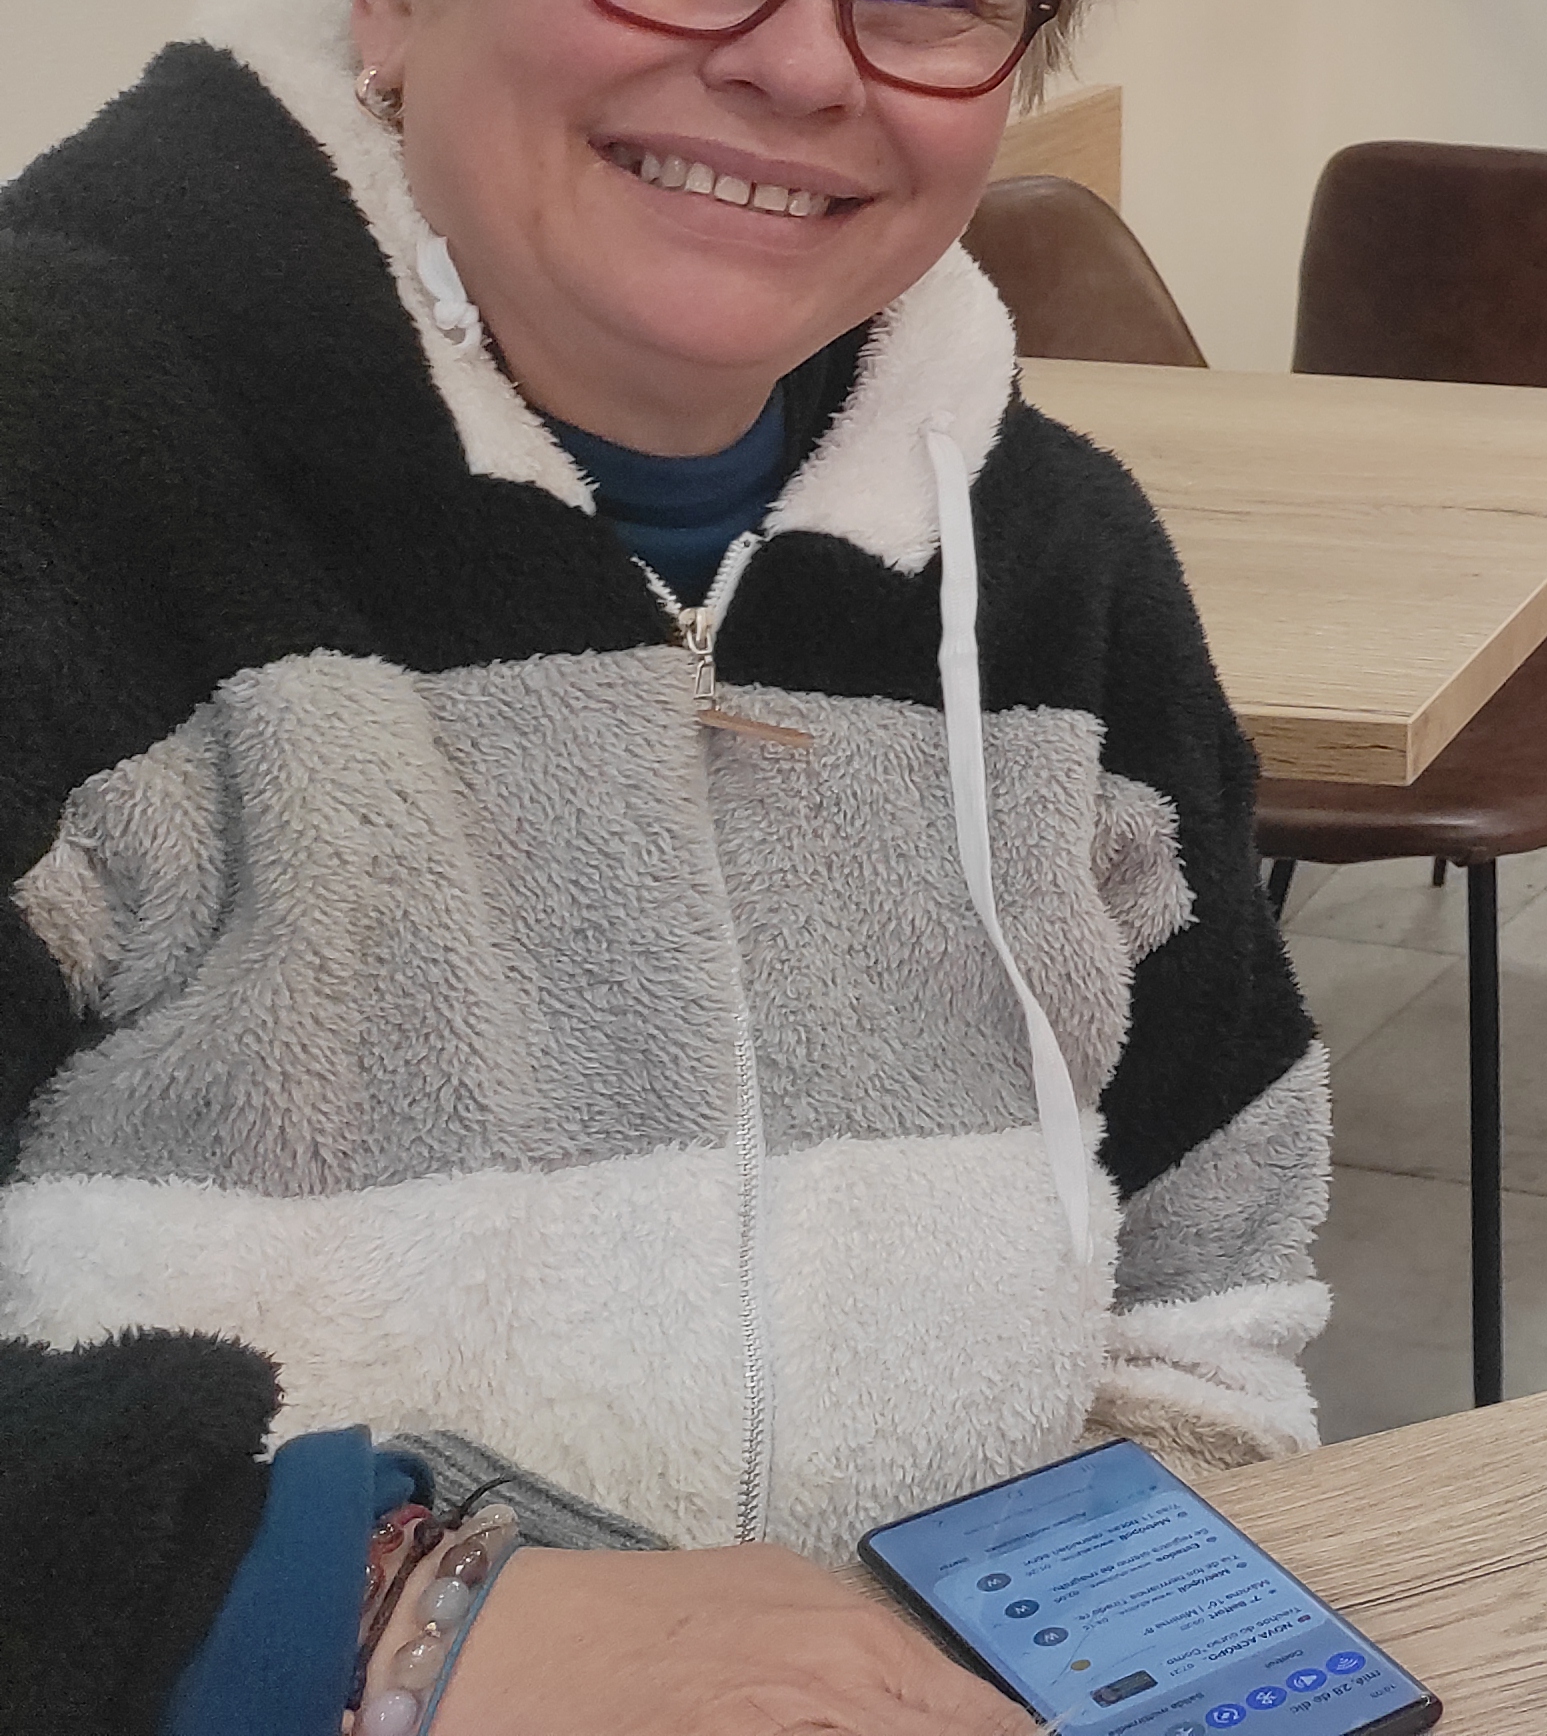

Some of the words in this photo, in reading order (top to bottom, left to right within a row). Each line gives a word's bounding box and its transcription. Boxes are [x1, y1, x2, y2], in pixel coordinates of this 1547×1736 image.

[1257, 1621, 1293, 1639] NOVA
[1331, 1682, 1352, 1695] 28
[1288, 1700, 1313, 1714] dic
